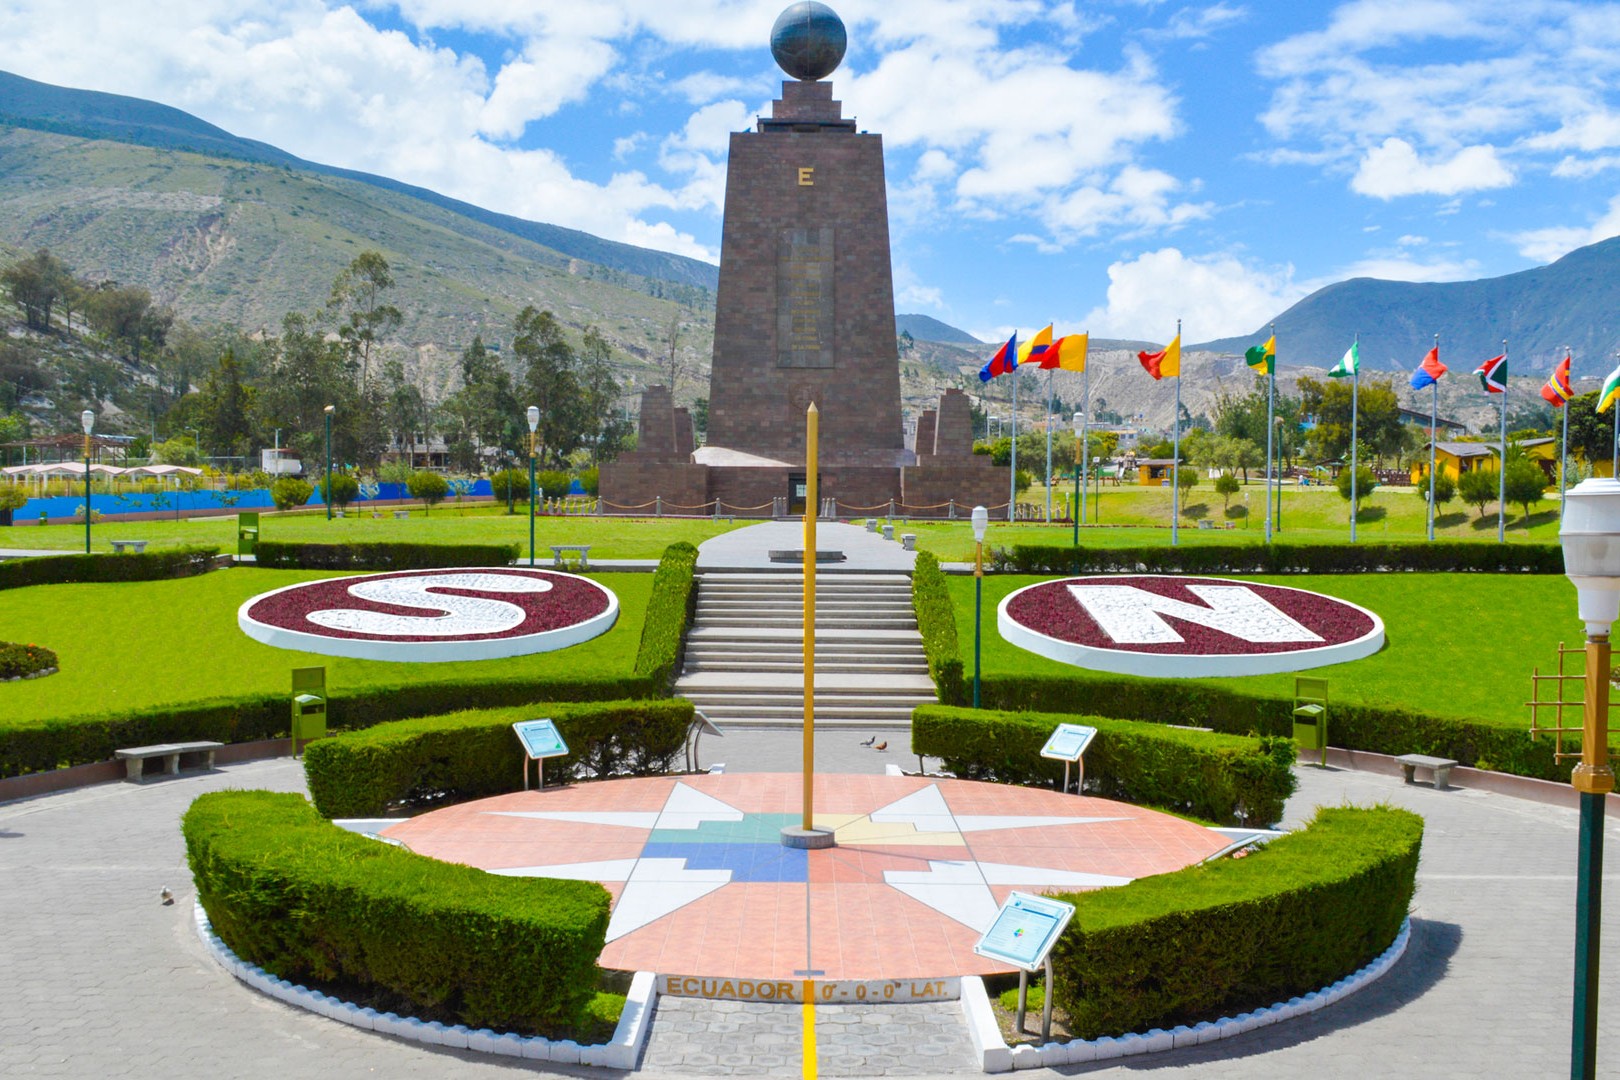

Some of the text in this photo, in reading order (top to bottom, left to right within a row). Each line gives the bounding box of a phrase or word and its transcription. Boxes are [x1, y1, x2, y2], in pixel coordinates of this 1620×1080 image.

[798, 167, 814, 186] E
[306, 574, 553, 635] S
[1066, 584, 1325, 643] N
[667, 977, 795, 1000] ECUADOR
[910, 981, 948, 998] LAT.
